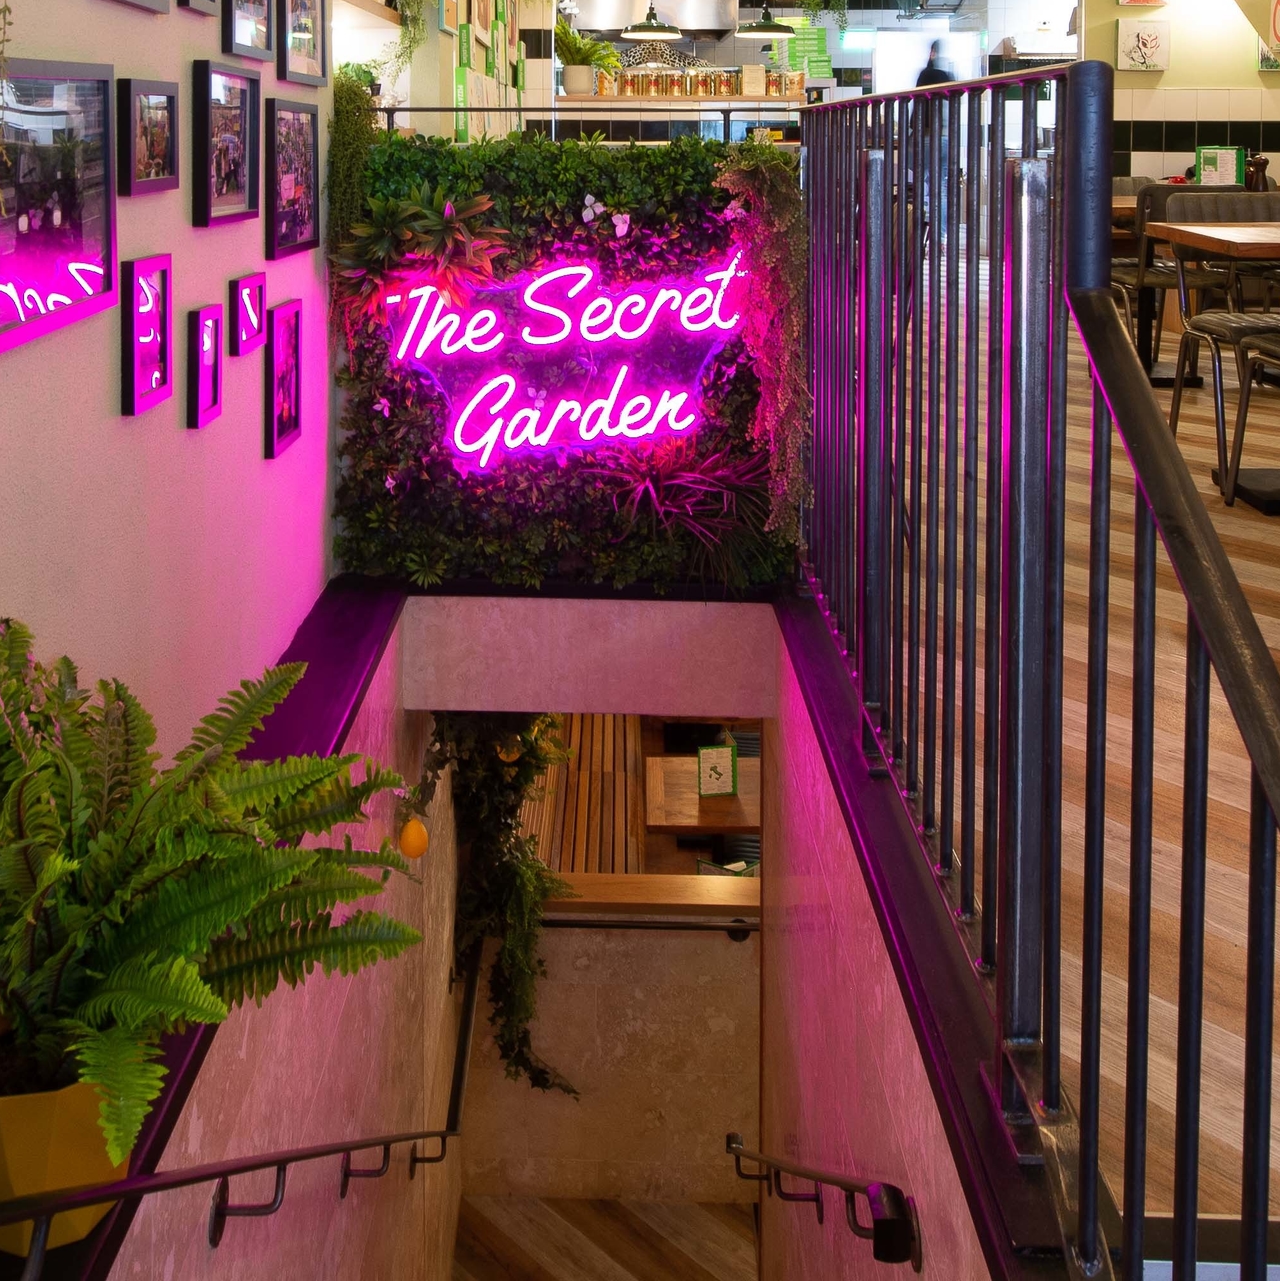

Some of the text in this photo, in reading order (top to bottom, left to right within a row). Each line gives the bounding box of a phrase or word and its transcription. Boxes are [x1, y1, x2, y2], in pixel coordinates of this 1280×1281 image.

[387, 250, 749, 360] The Secret
[453, 365, 696, 468] Garden
